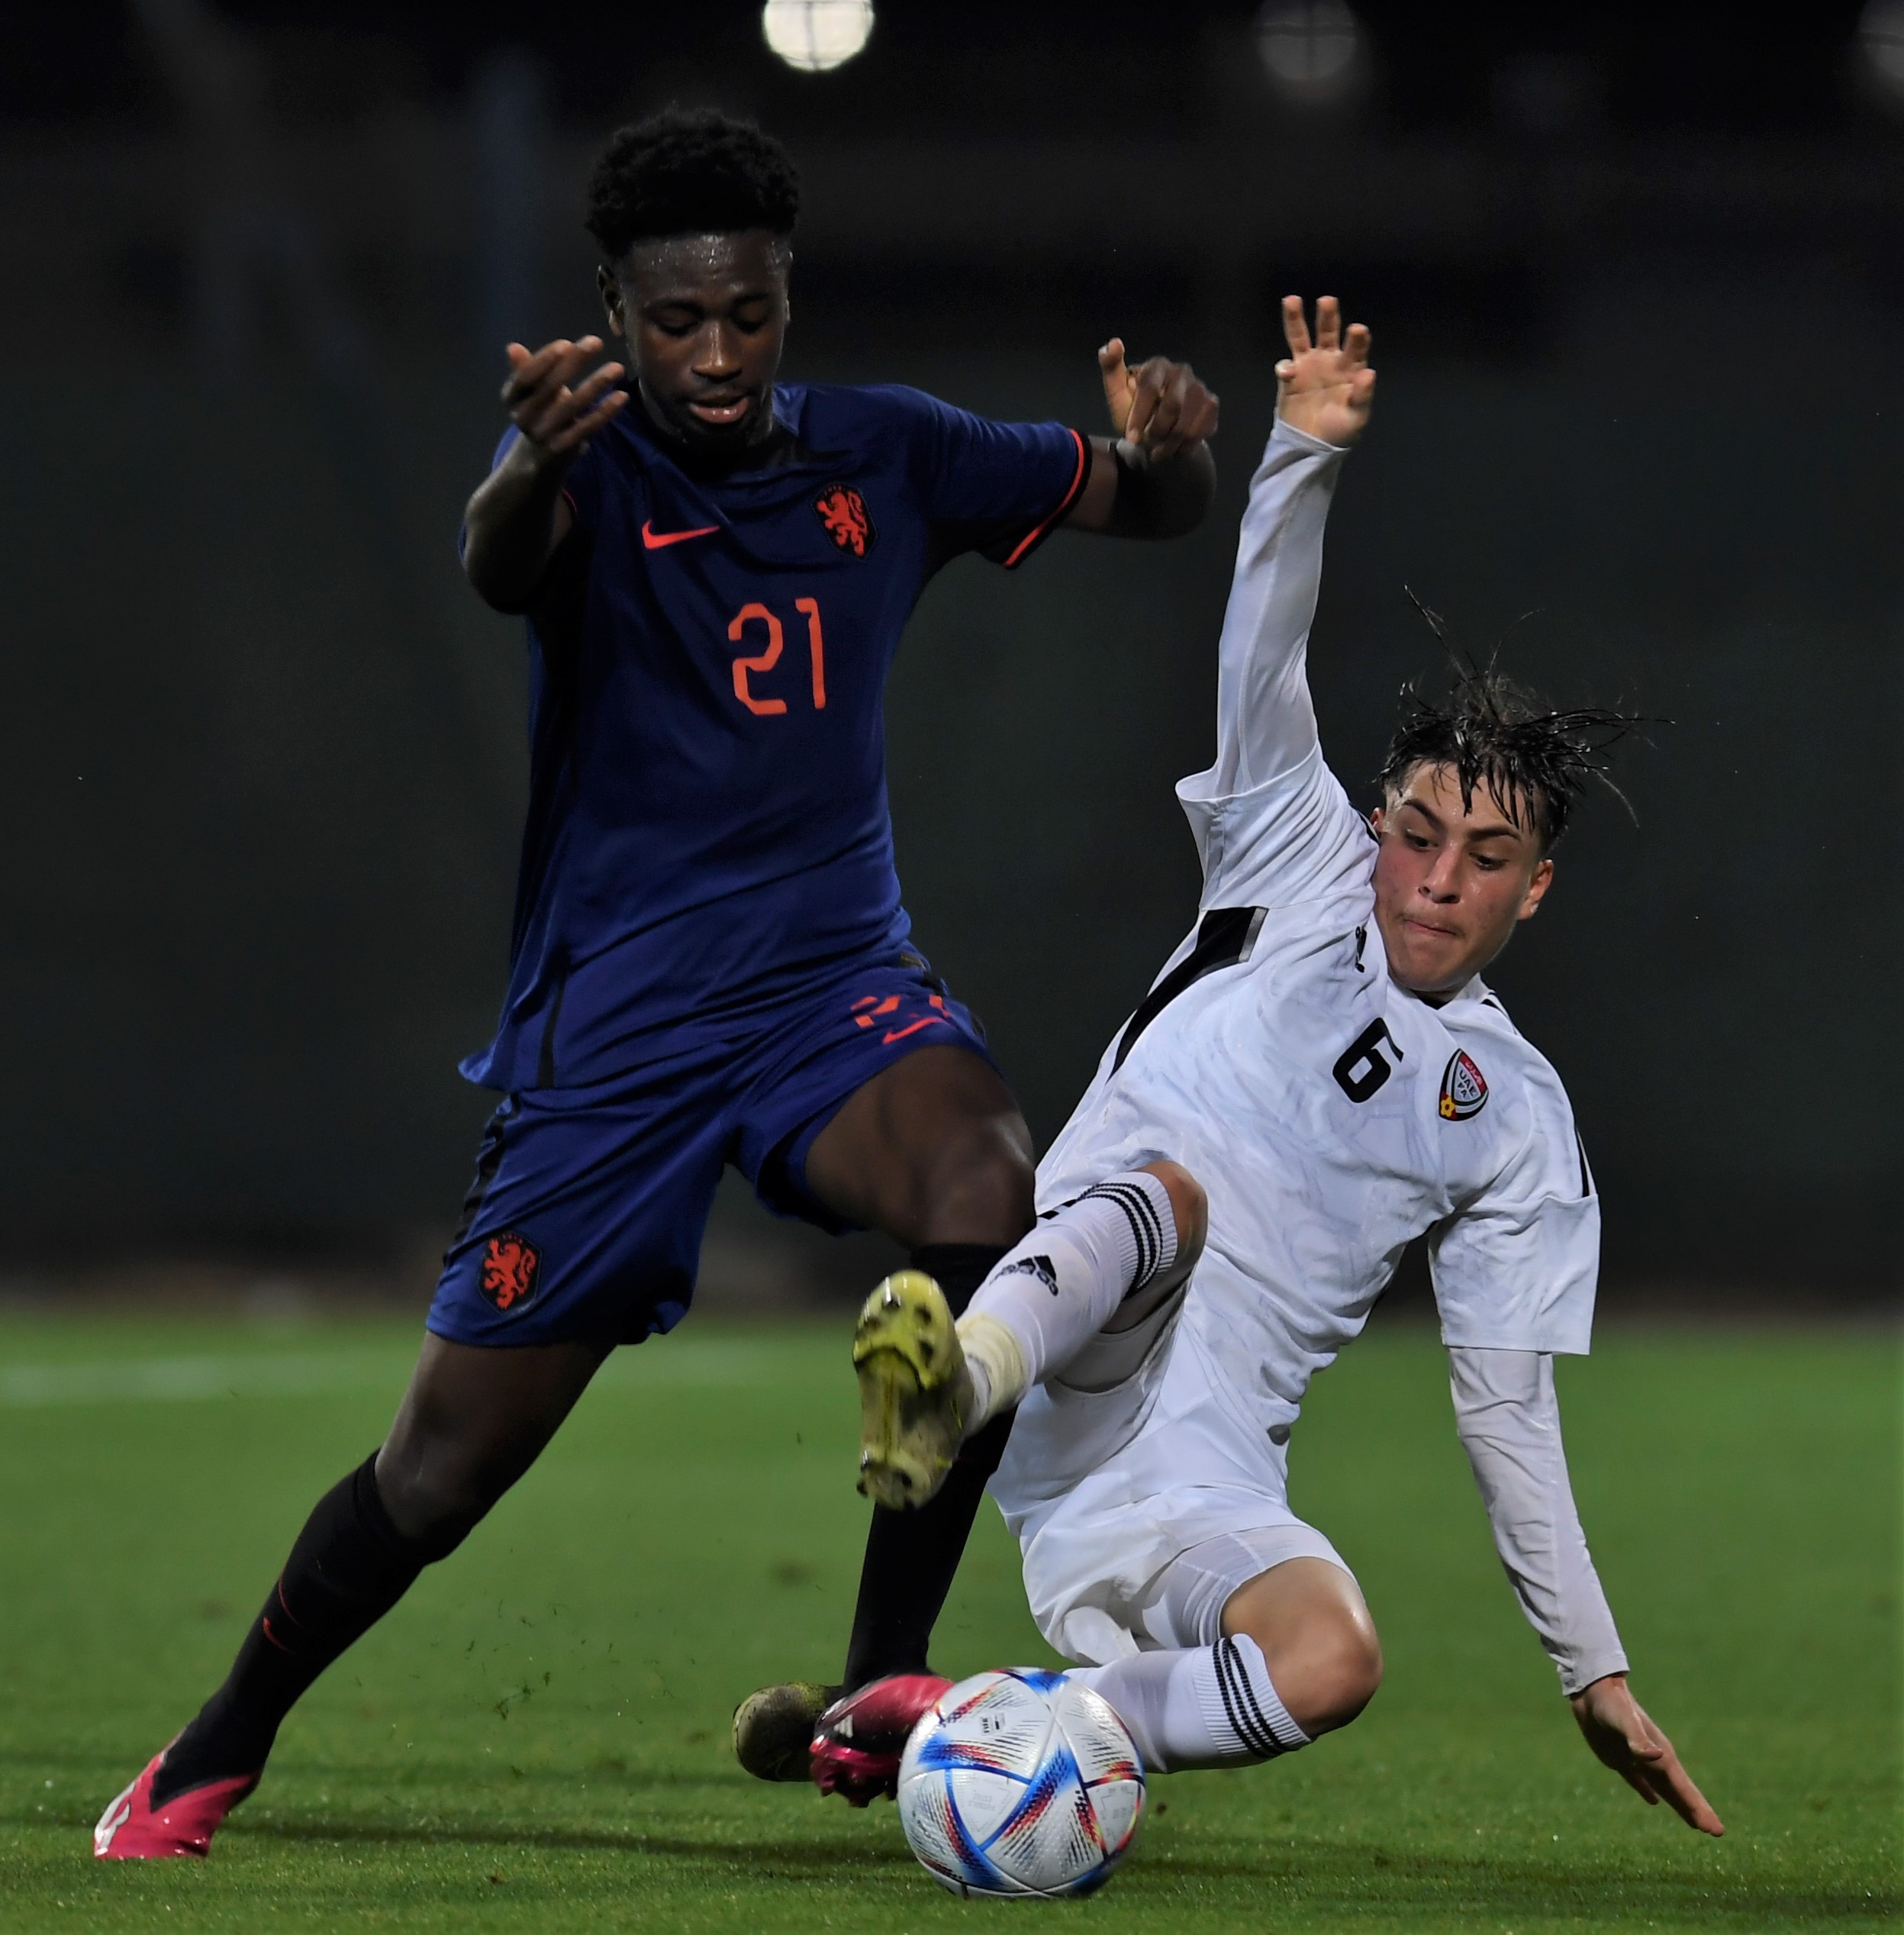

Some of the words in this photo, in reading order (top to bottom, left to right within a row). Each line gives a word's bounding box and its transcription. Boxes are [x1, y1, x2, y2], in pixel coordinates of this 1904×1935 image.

[728, 597, 826, 716] 21
[1332, 1017, 1404, 1103] 6
[1459, 1069, 1477, 1097] UAE
